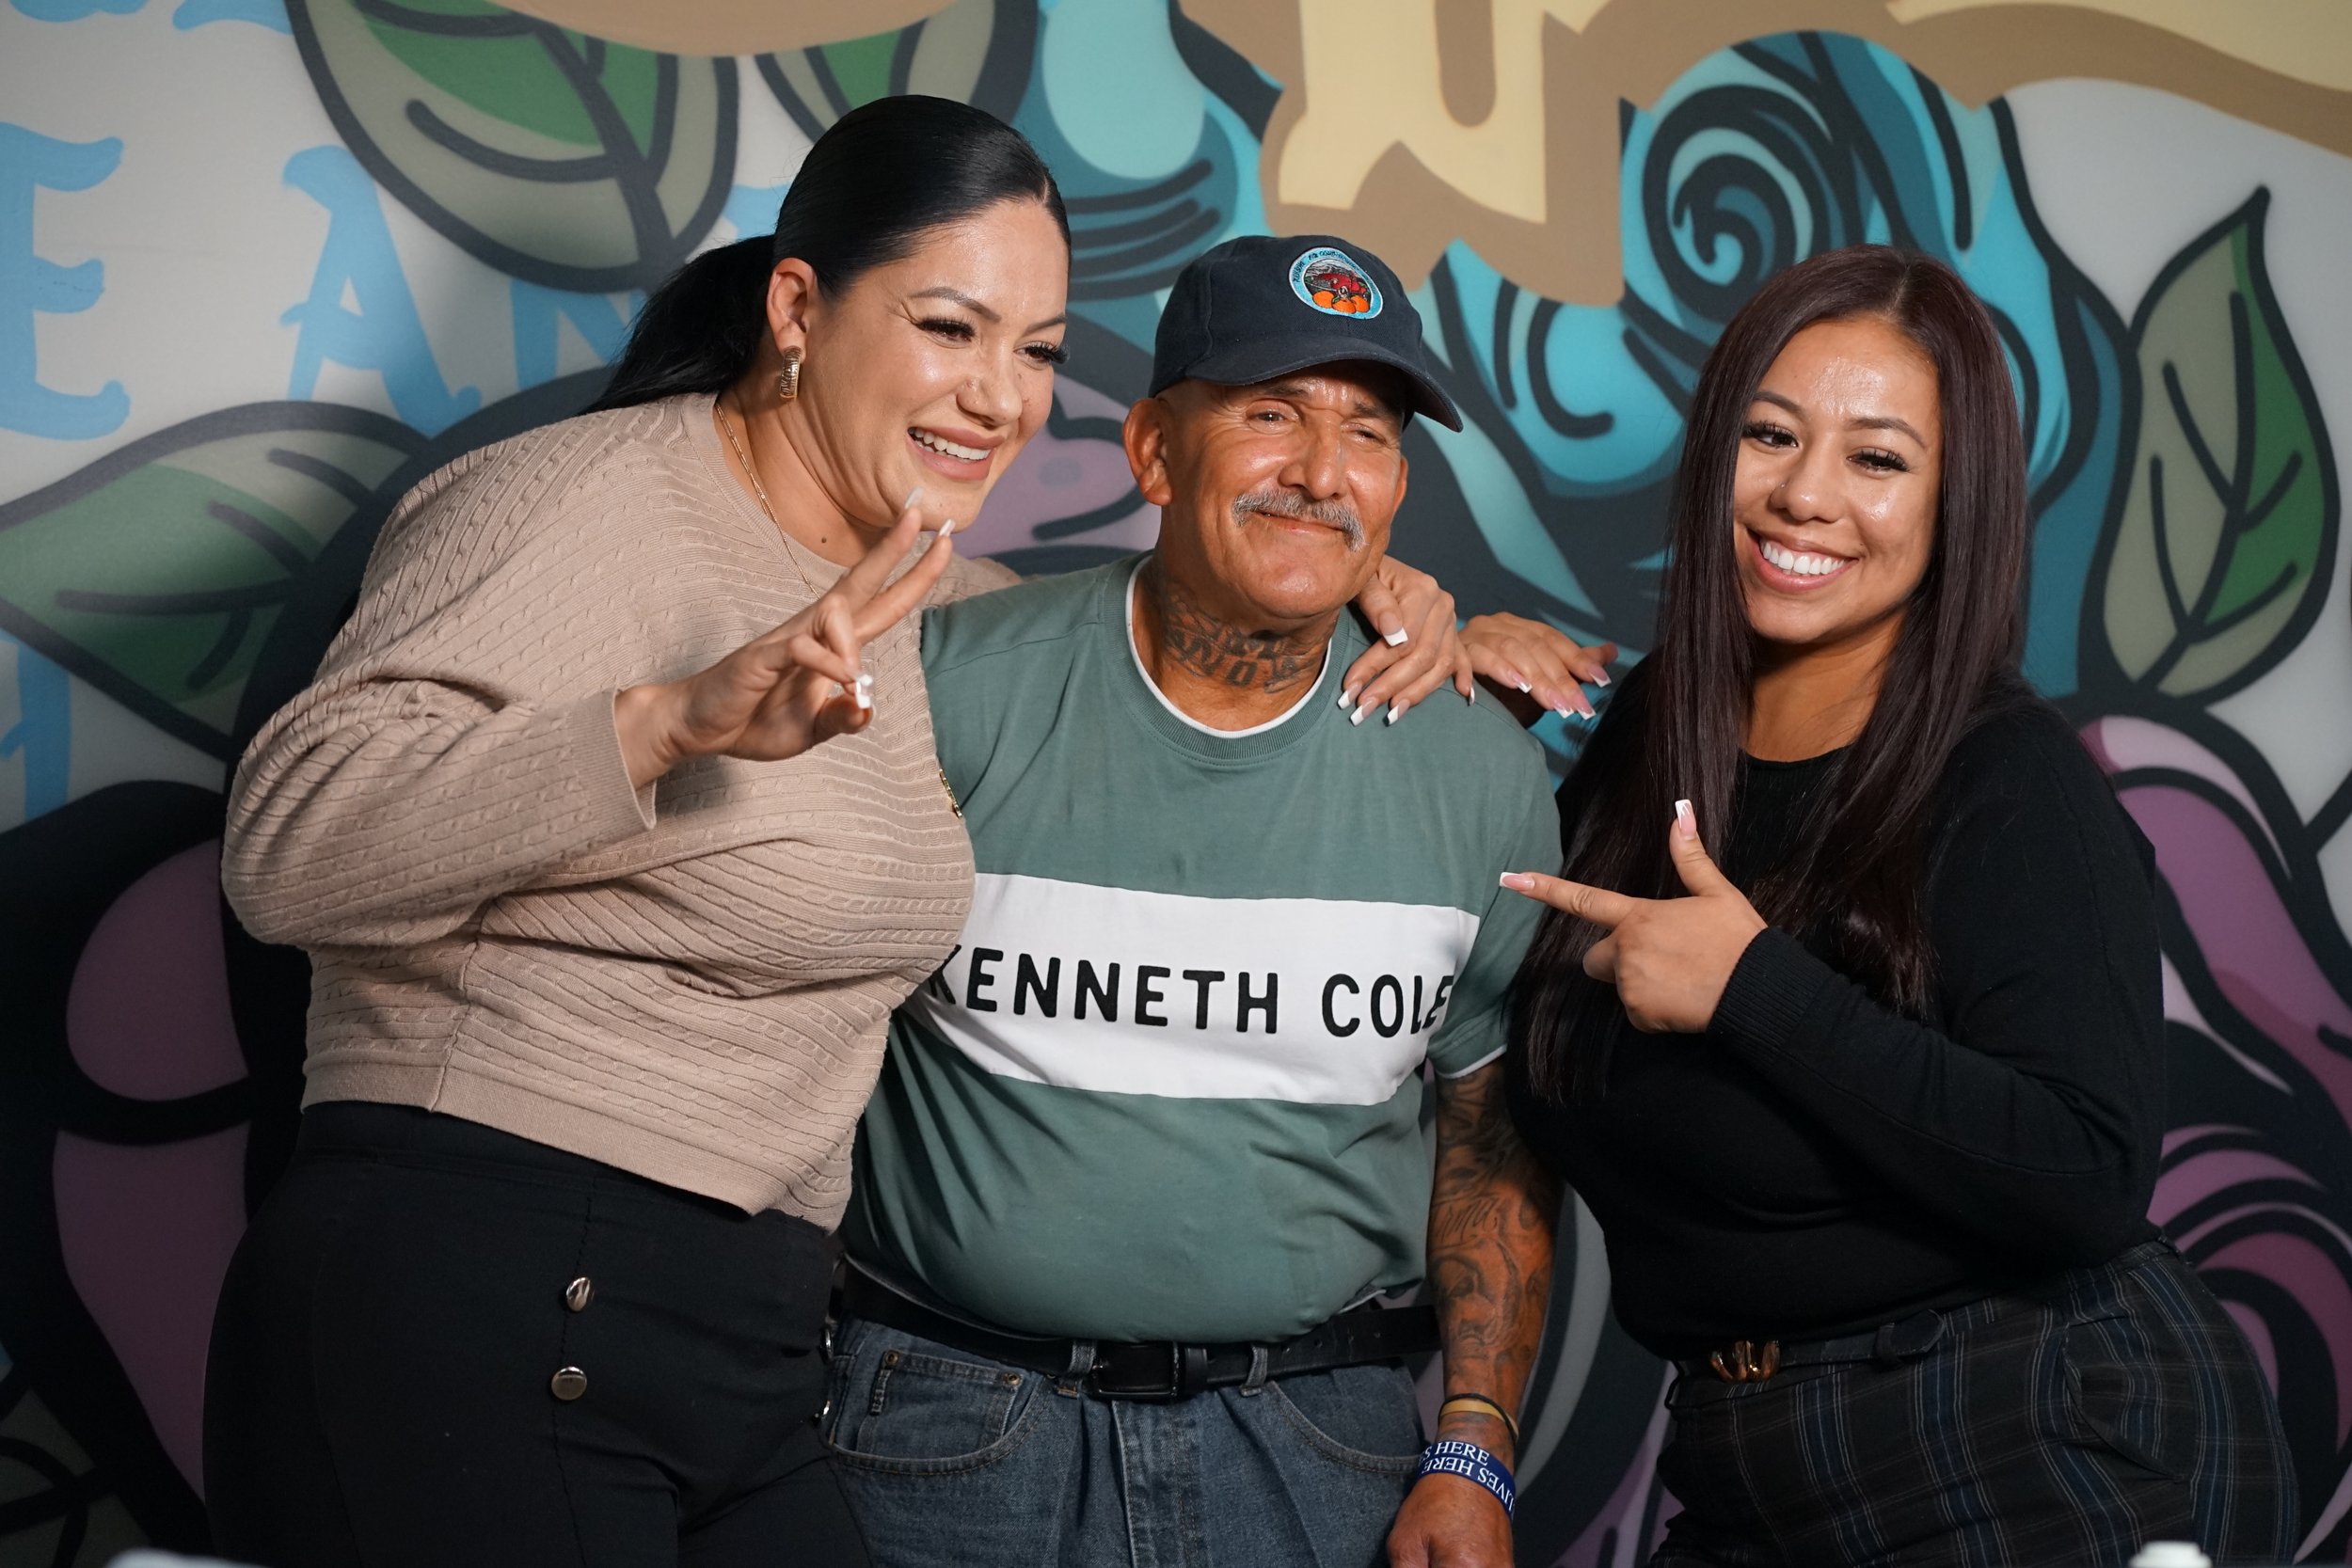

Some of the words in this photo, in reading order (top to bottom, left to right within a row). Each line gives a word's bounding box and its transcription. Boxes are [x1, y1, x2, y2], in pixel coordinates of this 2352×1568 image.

[929, 944, 1279, 1035] KENNETH
[1322, 973, 1454, 1038] COLE
[1422, 1456, 1475, 1477] HERE
[1435, 1441, 1490, 1466] HERE
[1477, 1467, 1515, 1512] LIVES
